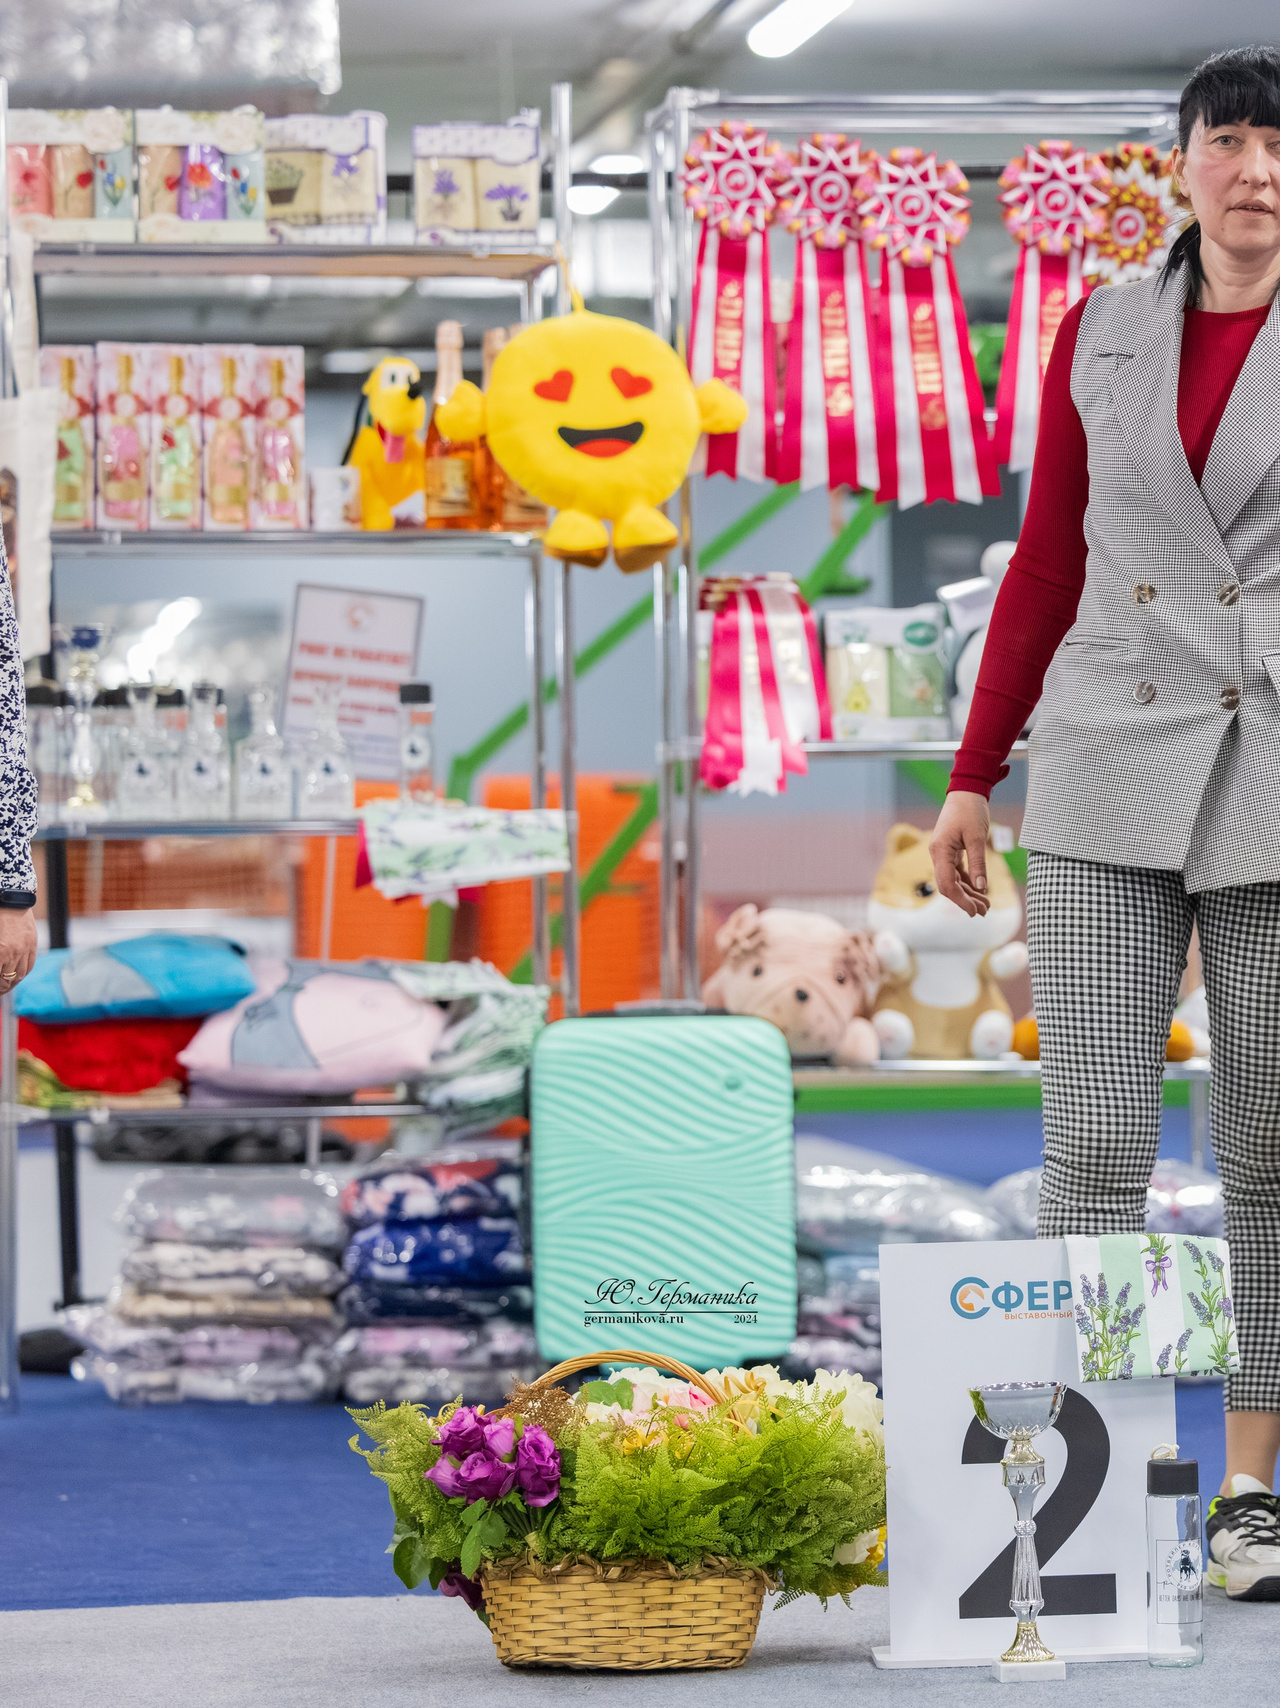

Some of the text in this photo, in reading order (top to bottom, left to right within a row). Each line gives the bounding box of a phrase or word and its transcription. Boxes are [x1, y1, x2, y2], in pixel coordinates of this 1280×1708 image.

[950, 1276, 1073, 1319] СФЕР
[1004, 1310, 1073, 1320] ВЫСТАВОЧНЫЙ
[959, 1383, 1117, 1619] 2
